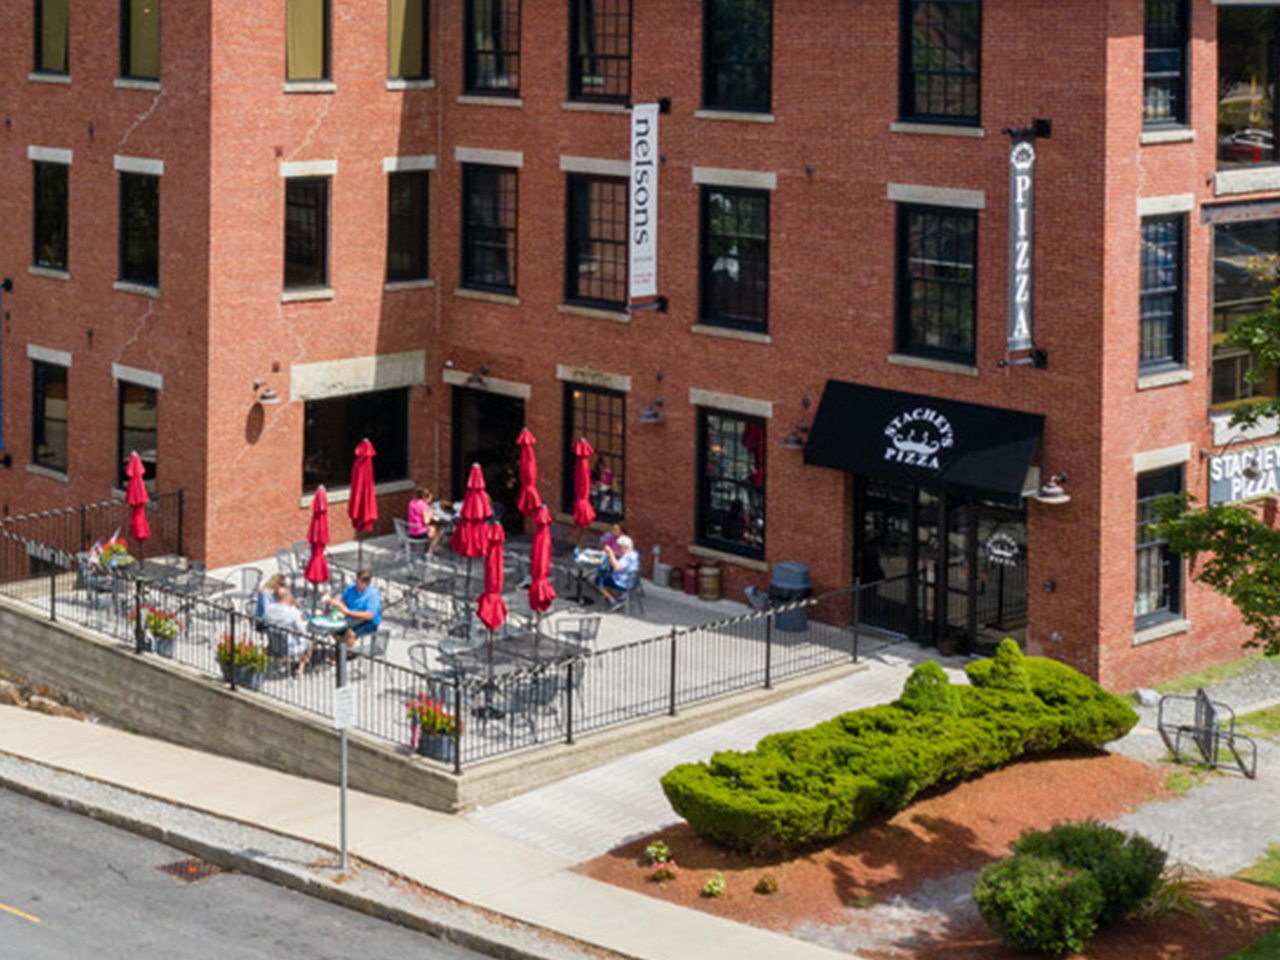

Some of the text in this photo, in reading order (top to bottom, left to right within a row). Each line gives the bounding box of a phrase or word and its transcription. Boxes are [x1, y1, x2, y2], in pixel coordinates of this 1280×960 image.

[634, 118, 653, 245] nelsons
[1013, 175, 1031, 338] PIZZA
[884, 408, 954, 447] STACHEY'S
[884, 448, 939, 468] PIZZA
[1231, 469, 1276, 501] PIZZA
